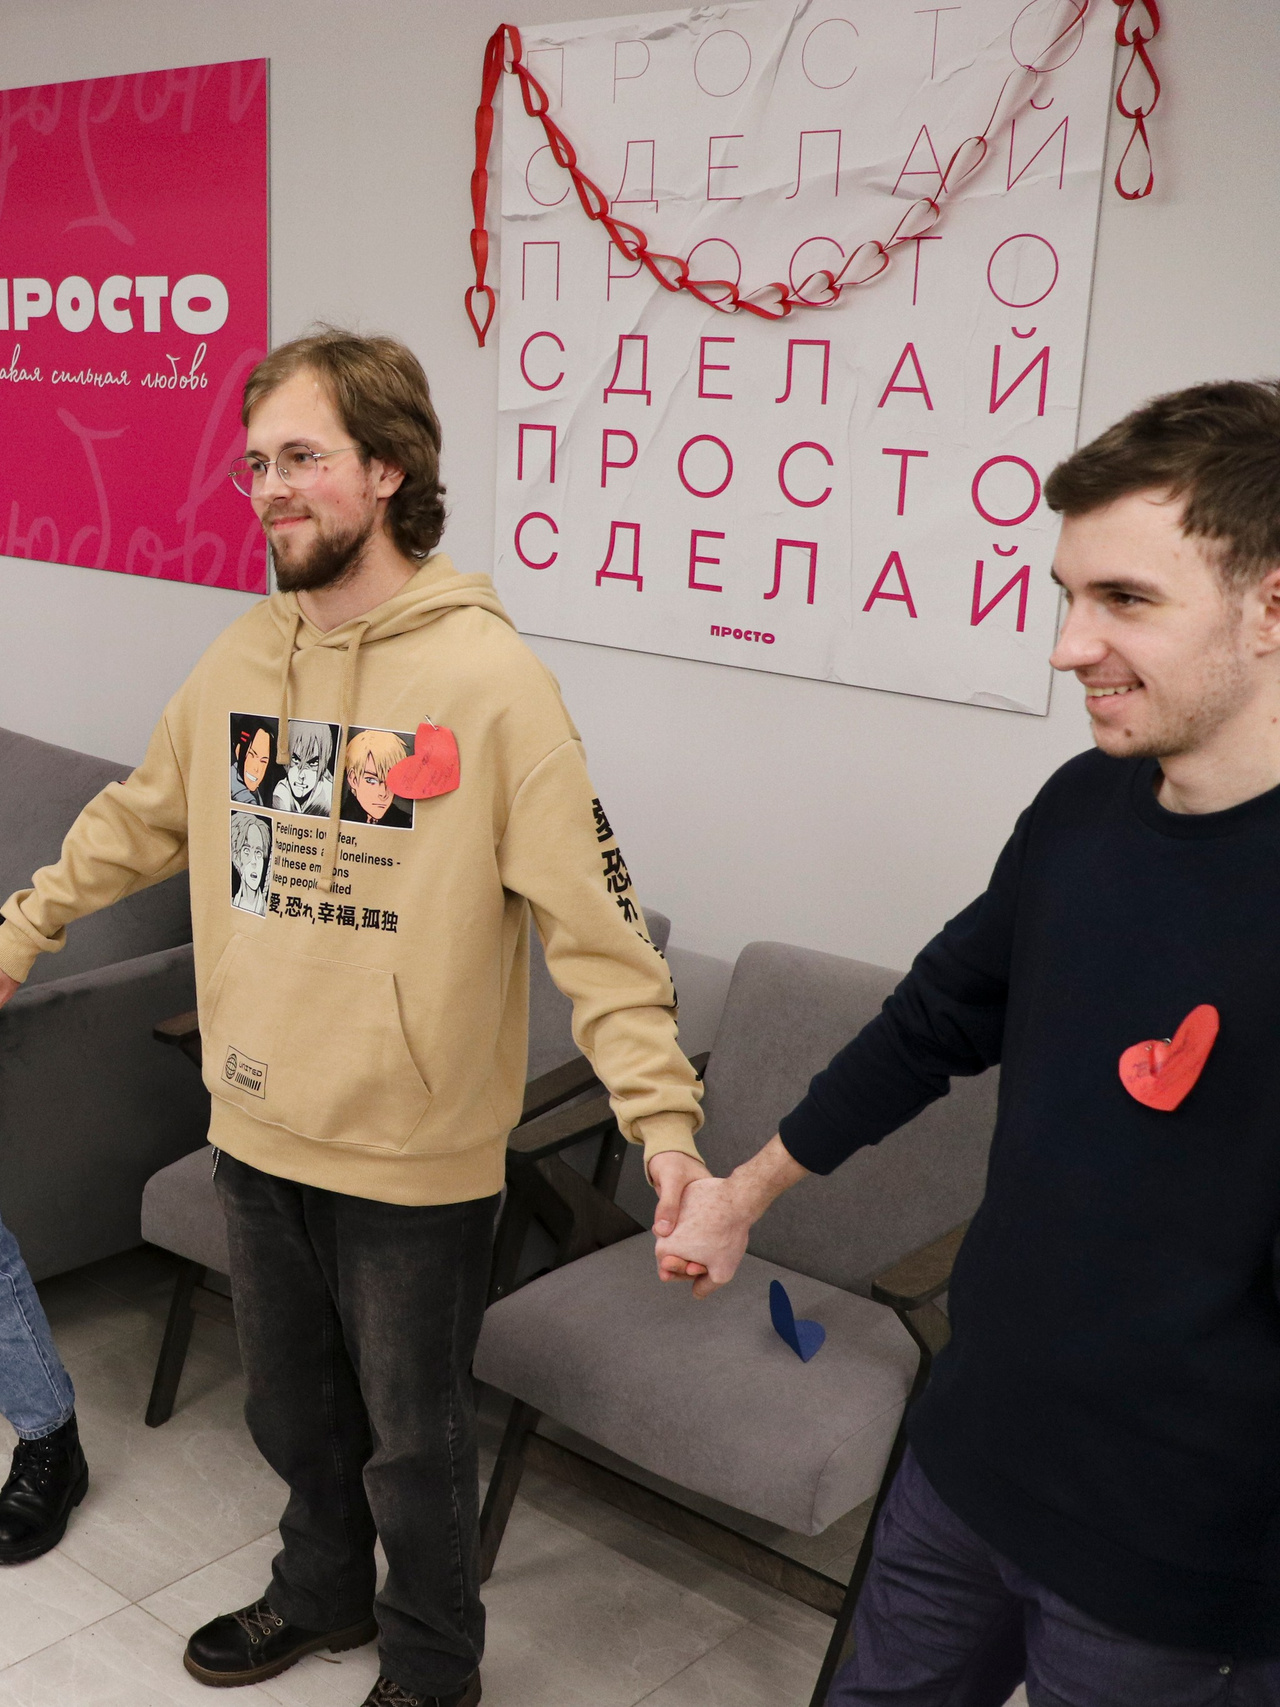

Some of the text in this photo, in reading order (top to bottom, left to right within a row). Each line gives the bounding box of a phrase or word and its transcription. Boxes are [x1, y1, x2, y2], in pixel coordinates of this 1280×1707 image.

[526, 0, 1085, 108] ПРОСТО
[526, 98, 1069, 214] СДЕЛАЙ
[522, 234, 1059, 309] ПРОСТО
[51, 368, 132, 388] сильная
[141, 342, 208, 390] любовь
[520, 326, 1051, 417] СДЕЛАЙ
[517, 423, 1042, 527] ПРОСТО
[514, 511, 1031, 633] СДЕЛАЙ
[710, 624, 776, 645] ПРОСТО
[276, 821, 313, 840] Feelings:
[281, 856, 307, 871] these
[340, 849, 394, 867] loneliness
